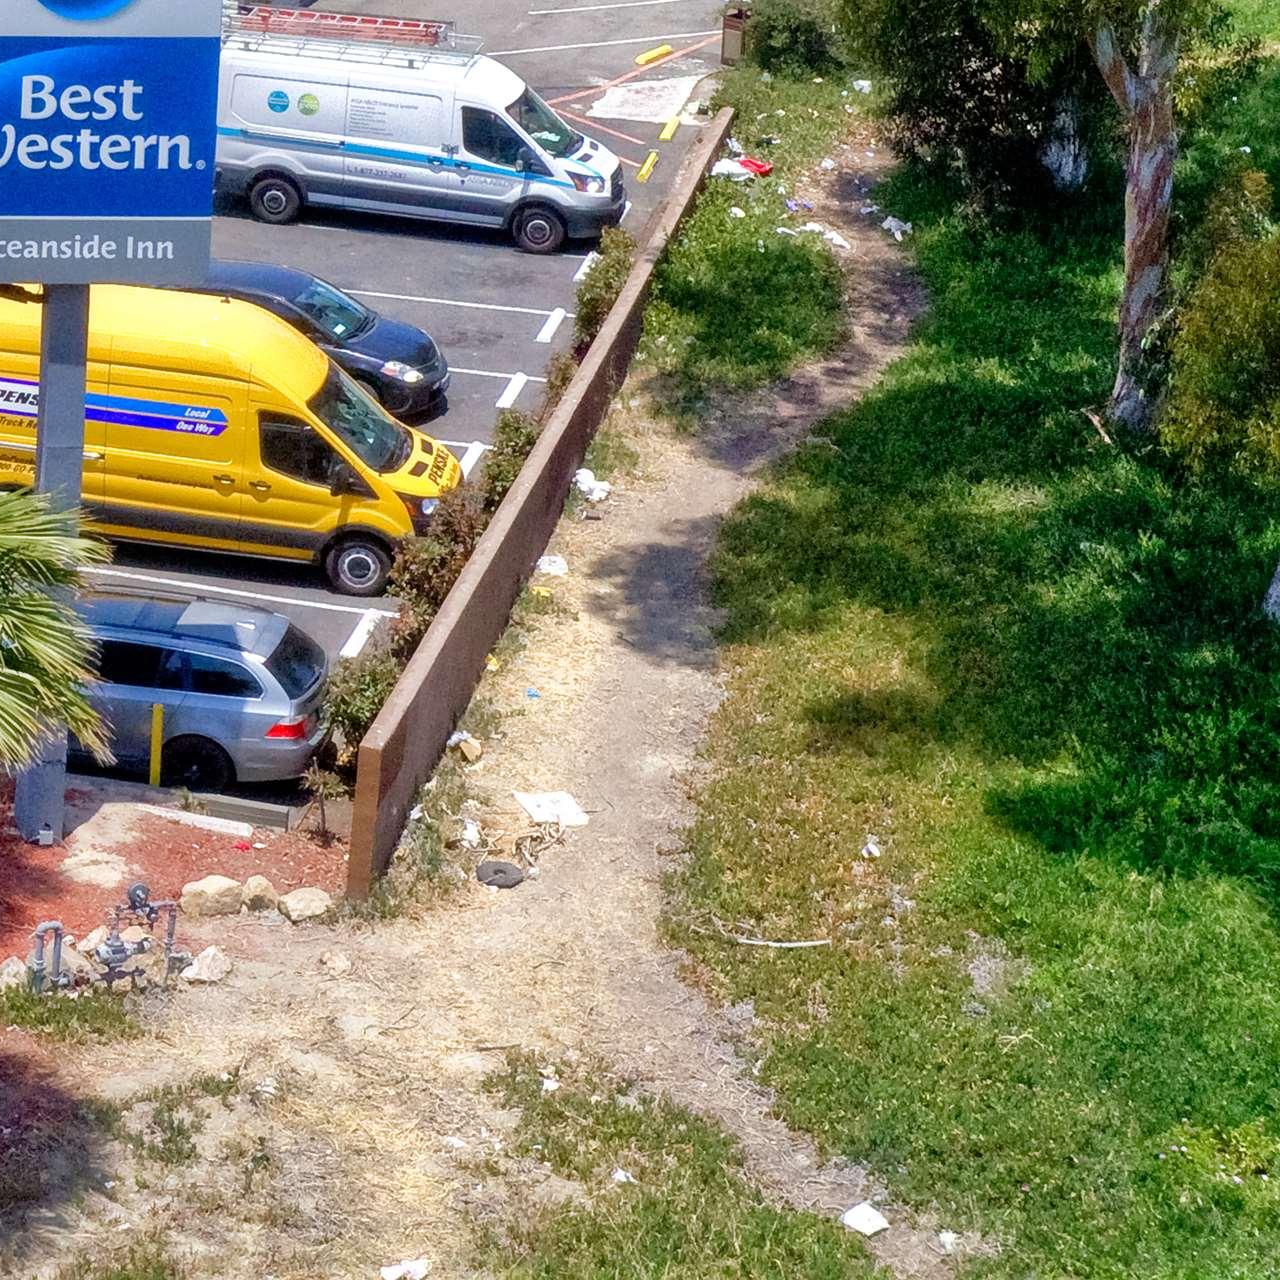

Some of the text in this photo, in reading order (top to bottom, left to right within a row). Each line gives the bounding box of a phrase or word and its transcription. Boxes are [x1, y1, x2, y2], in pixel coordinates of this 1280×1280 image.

[20, 74, 144, 121] Best
[126, 236, 174, 260] Inn
[184, 408, 211, 418] Local
[176, 421, 215, 435] One Way
